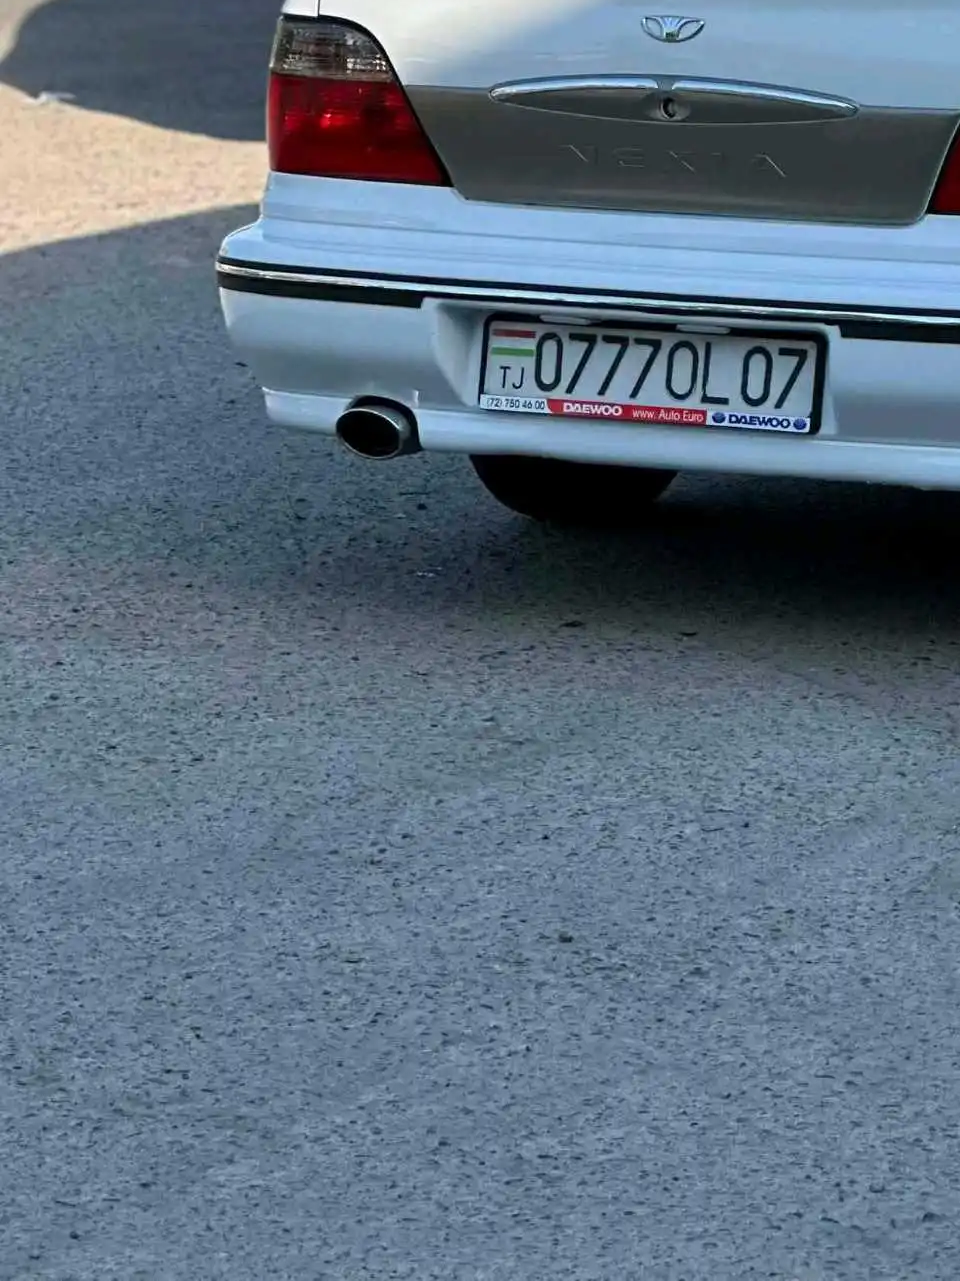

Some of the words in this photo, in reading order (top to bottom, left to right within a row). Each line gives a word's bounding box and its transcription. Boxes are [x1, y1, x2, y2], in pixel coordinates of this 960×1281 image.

[557, 144, 788, 178] NEXIA
[499, 365, 526, 390] TJ
[740, 345, 809, 410] 07
[563, 402, 623, 416] DAEWOO
[683, 410, 704, 423] Euro
[728, 413, 791, 429] DAEWOO
